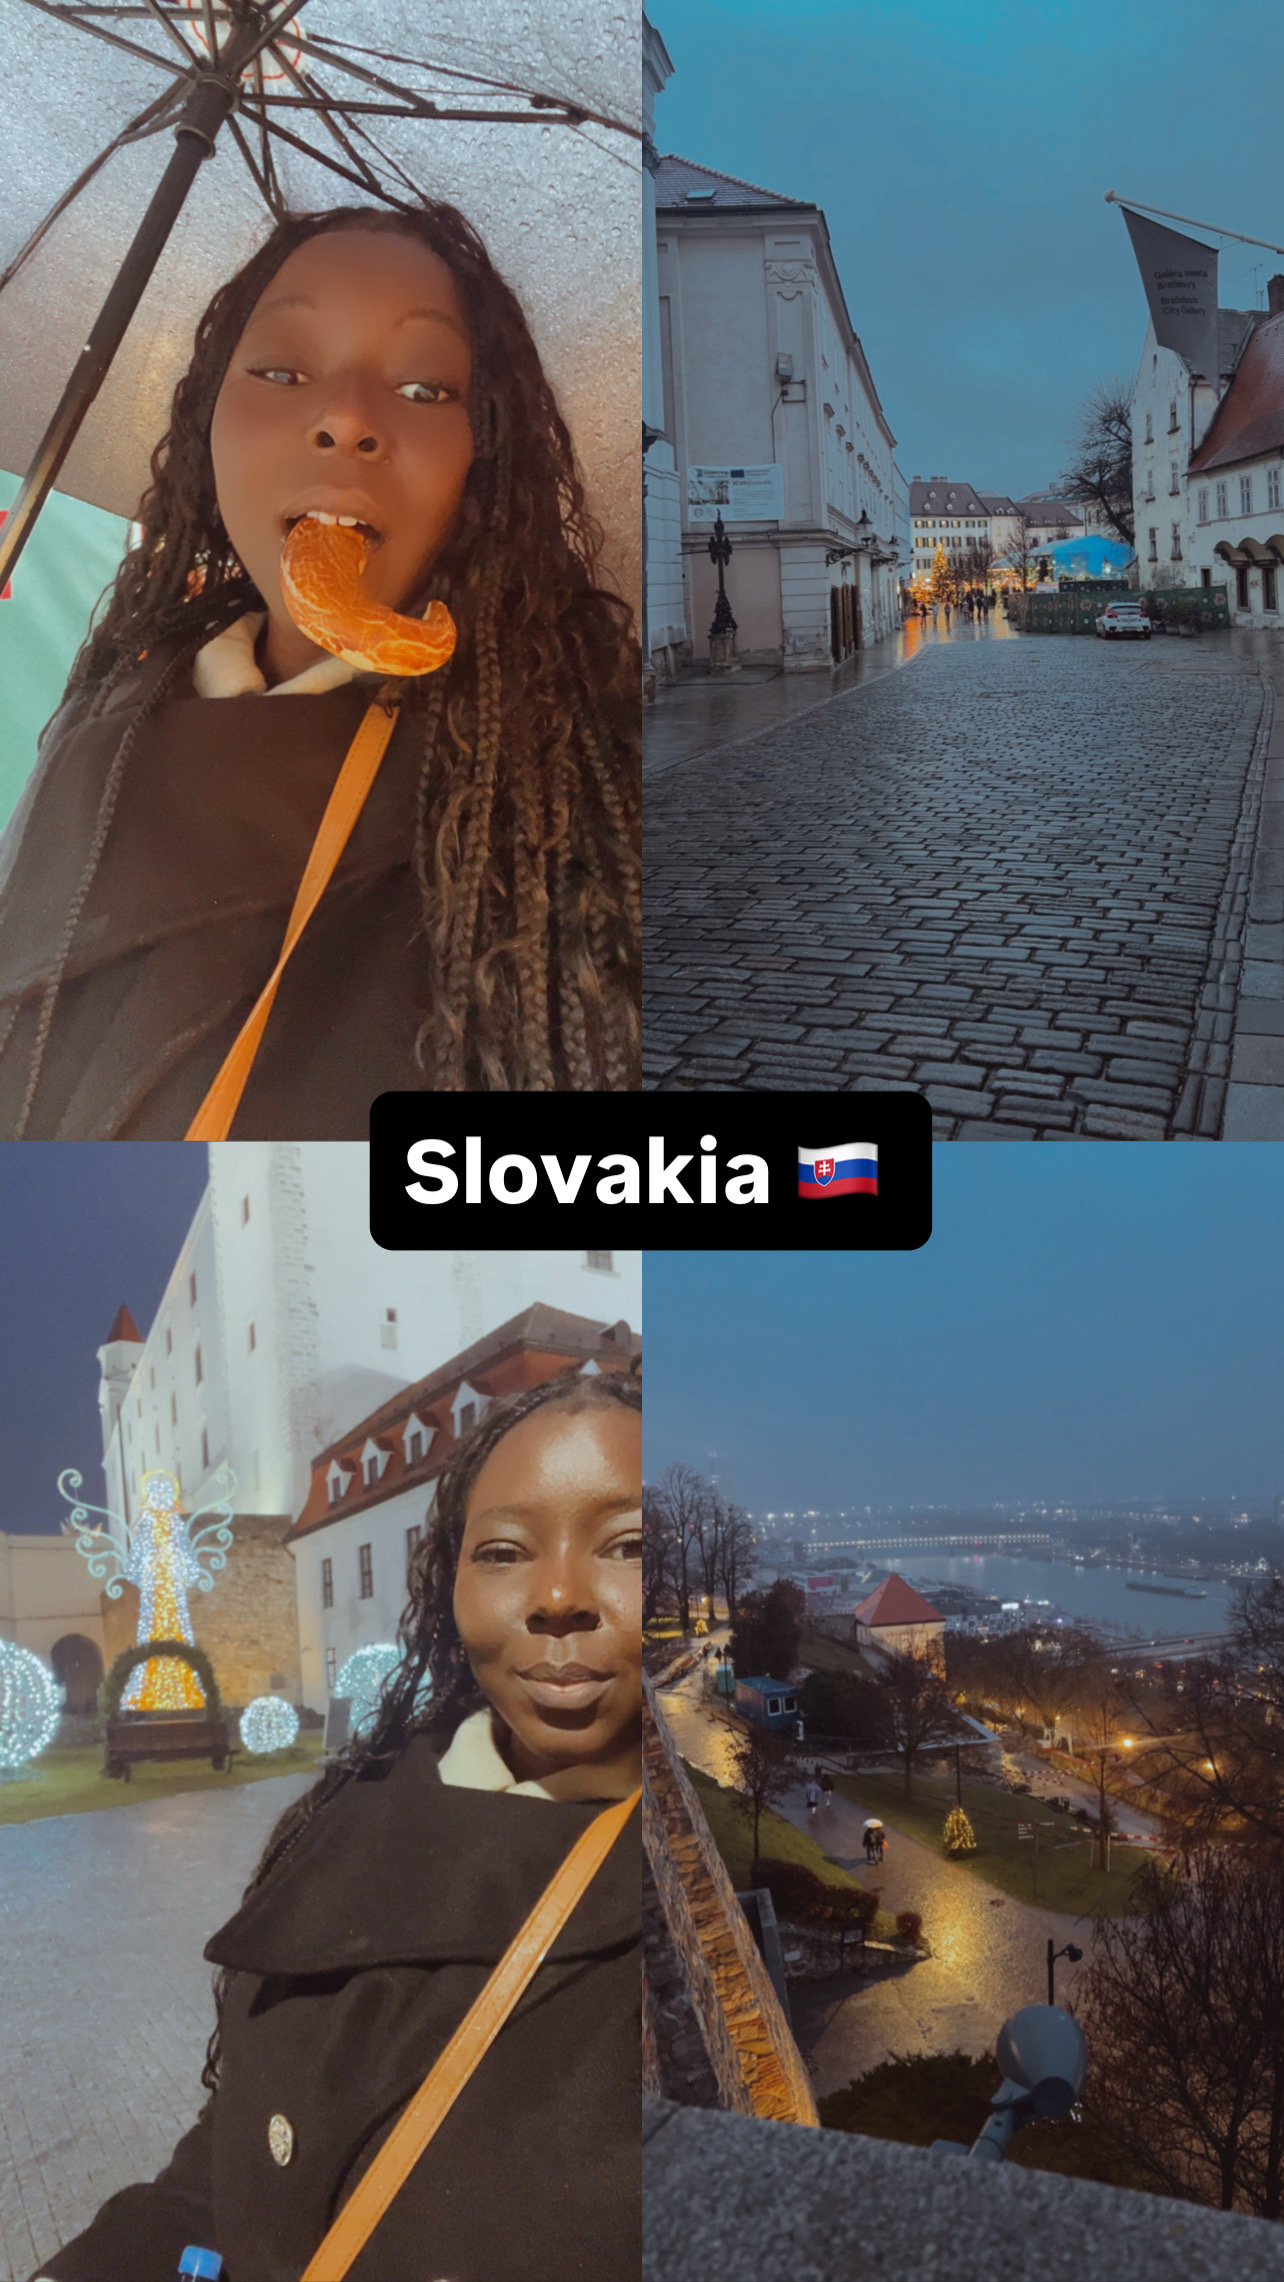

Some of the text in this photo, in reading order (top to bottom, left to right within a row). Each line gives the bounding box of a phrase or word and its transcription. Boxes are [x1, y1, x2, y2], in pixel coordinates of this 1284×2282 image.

[1185, 270, 1208, 278] mesta
[1160, 296, 1198, 305] Bratislava
[1163, 305, 1206, 317] City Gallery
